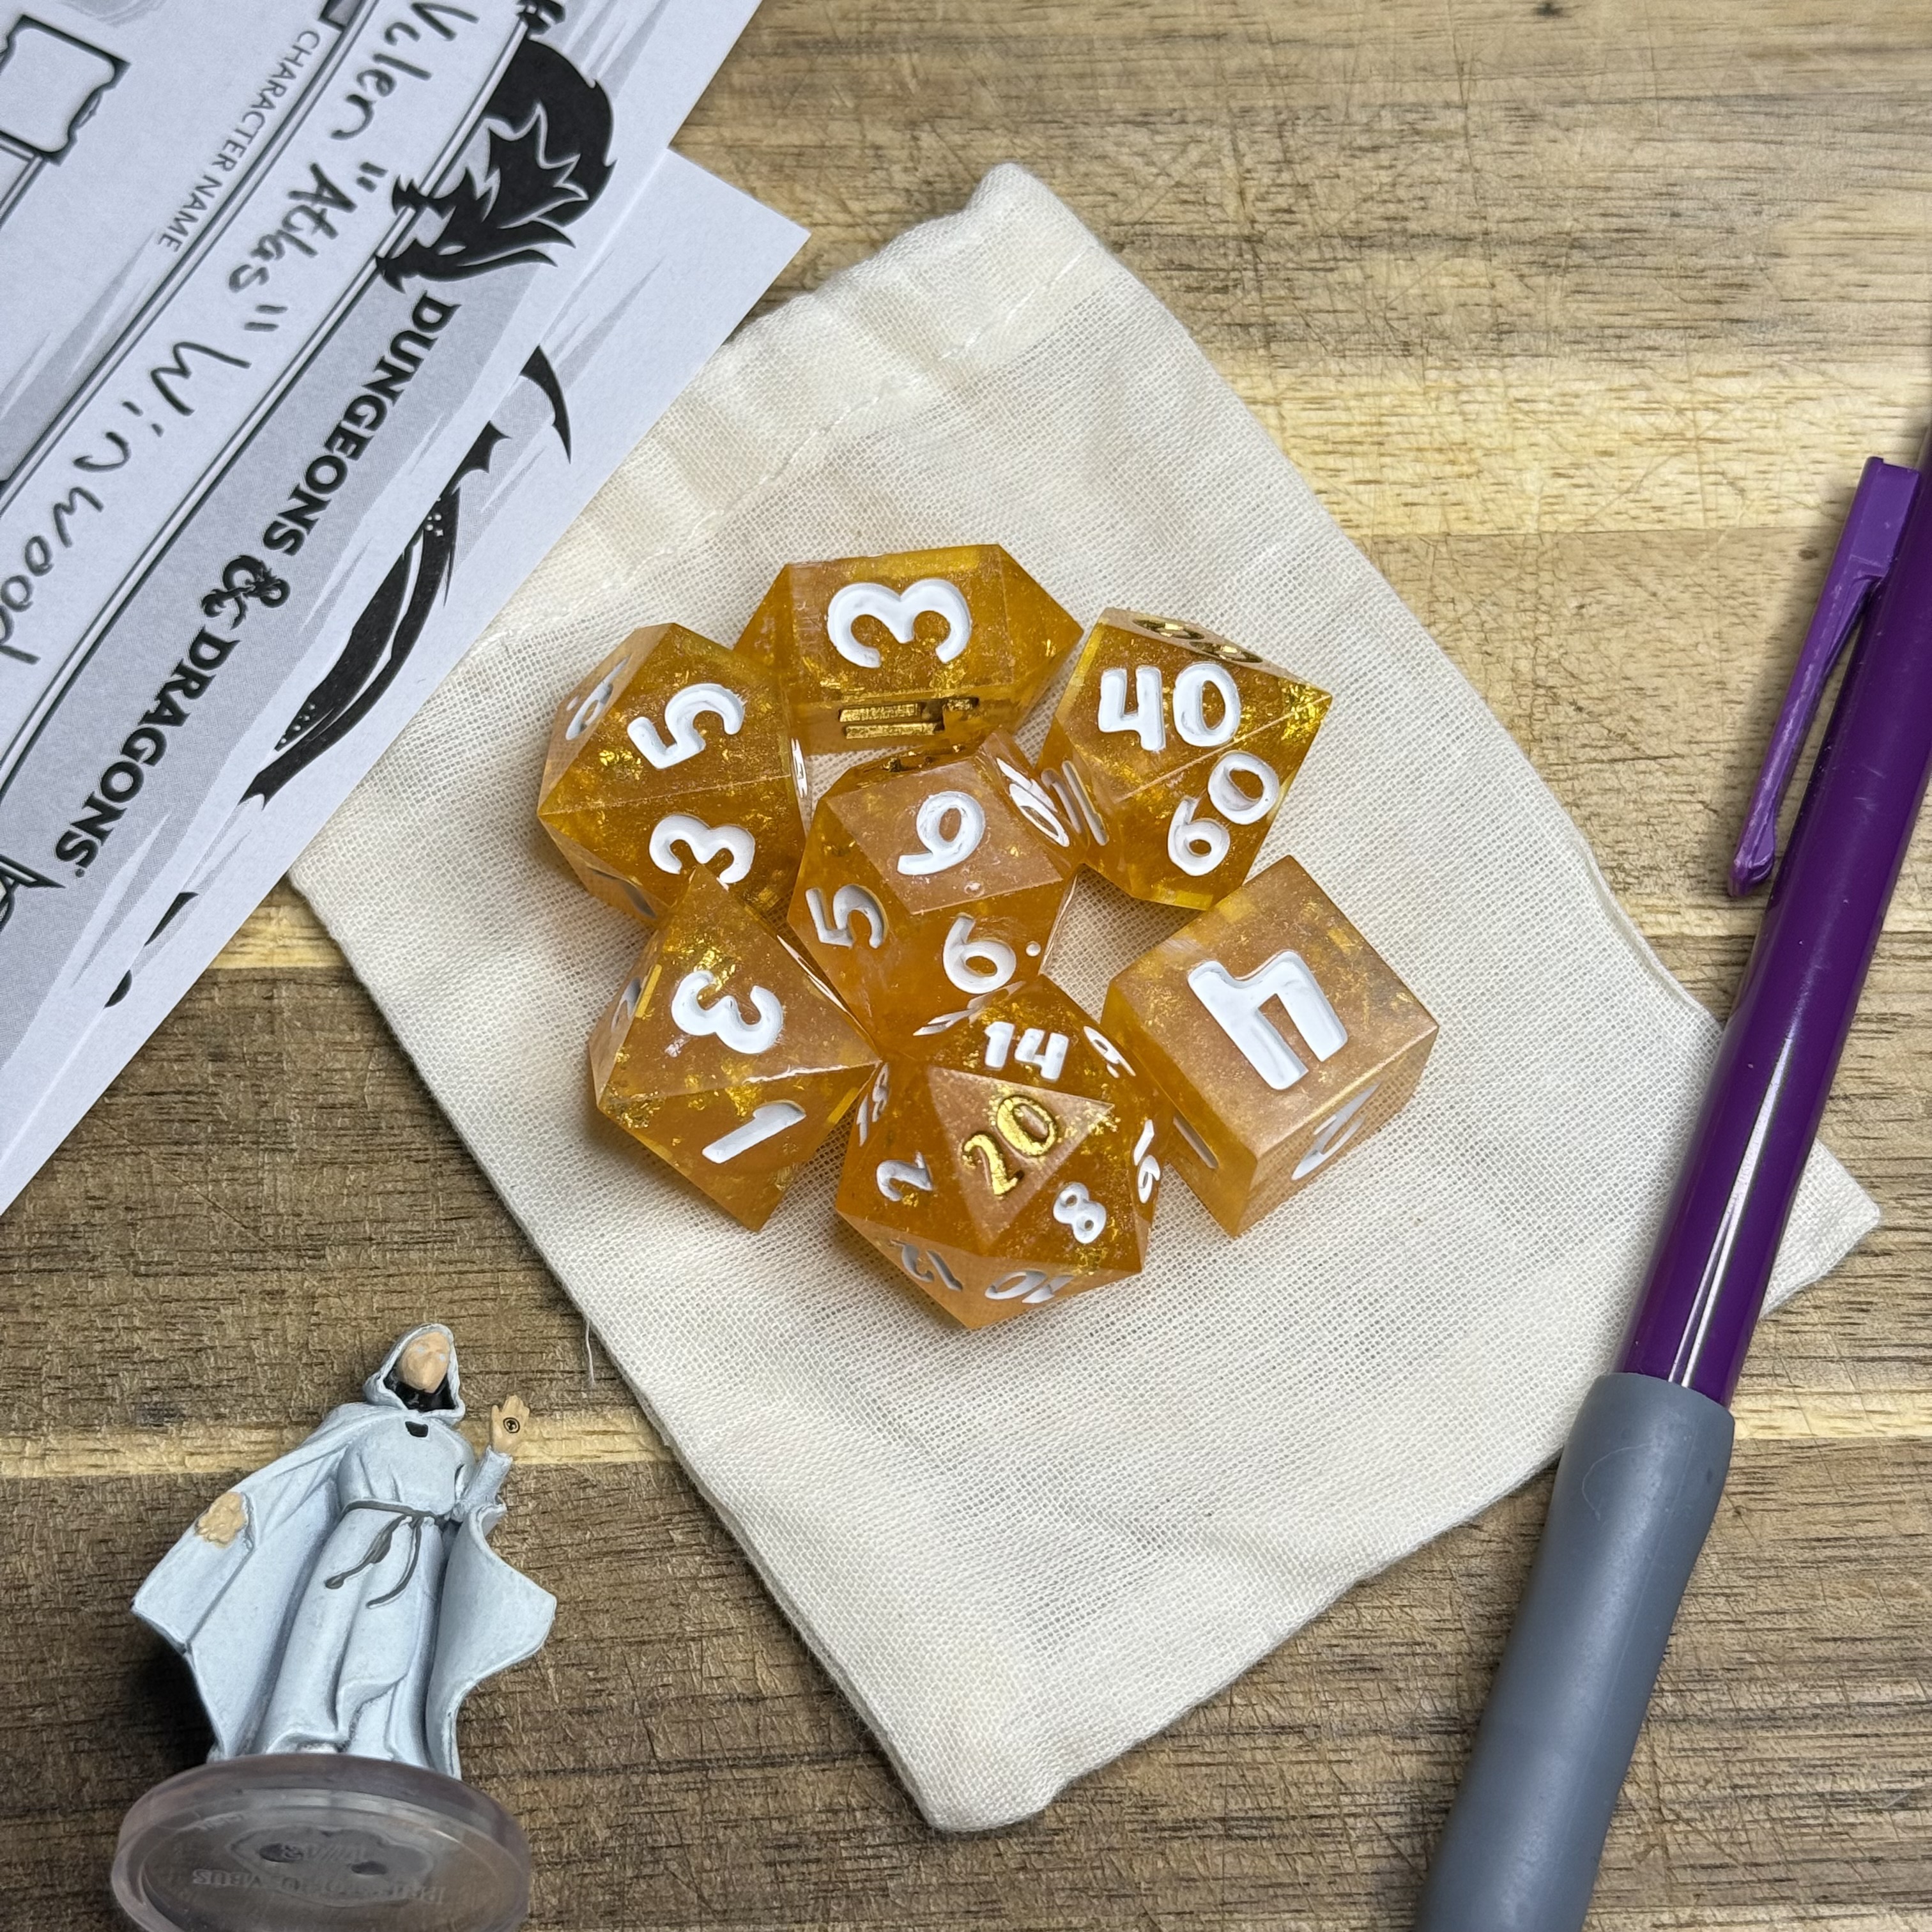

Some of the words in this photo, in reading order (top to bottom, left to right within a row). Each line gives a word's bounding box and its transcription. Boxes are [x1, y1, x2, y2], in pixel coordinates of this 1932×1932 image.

[211, 29, 320, 172] CHARACTER
[157, 174, 223, 252] NAME
[263, 290, 462, 556] DUNGEONS
[827, 578, 972, 668] 3
[627, 683, 746, 769] 5
[1098, 662, 1241, 752] 40
[649, 813, 755, 883] 3
[1168, 749, 1280, 877] 60
[805, 884, 890, 949] 5
[671, 970, 784, 1054] 3
[984, 1021, 1070, 1081] 14
[1188, 949, 1348, 1090] 4
[703, 1100, 807, 1164] 1
[961, 1093, 1060, 1197] 20
[876, 1150, 933, 1202] 2
[1053, 1181, 1107, 1245] 8
